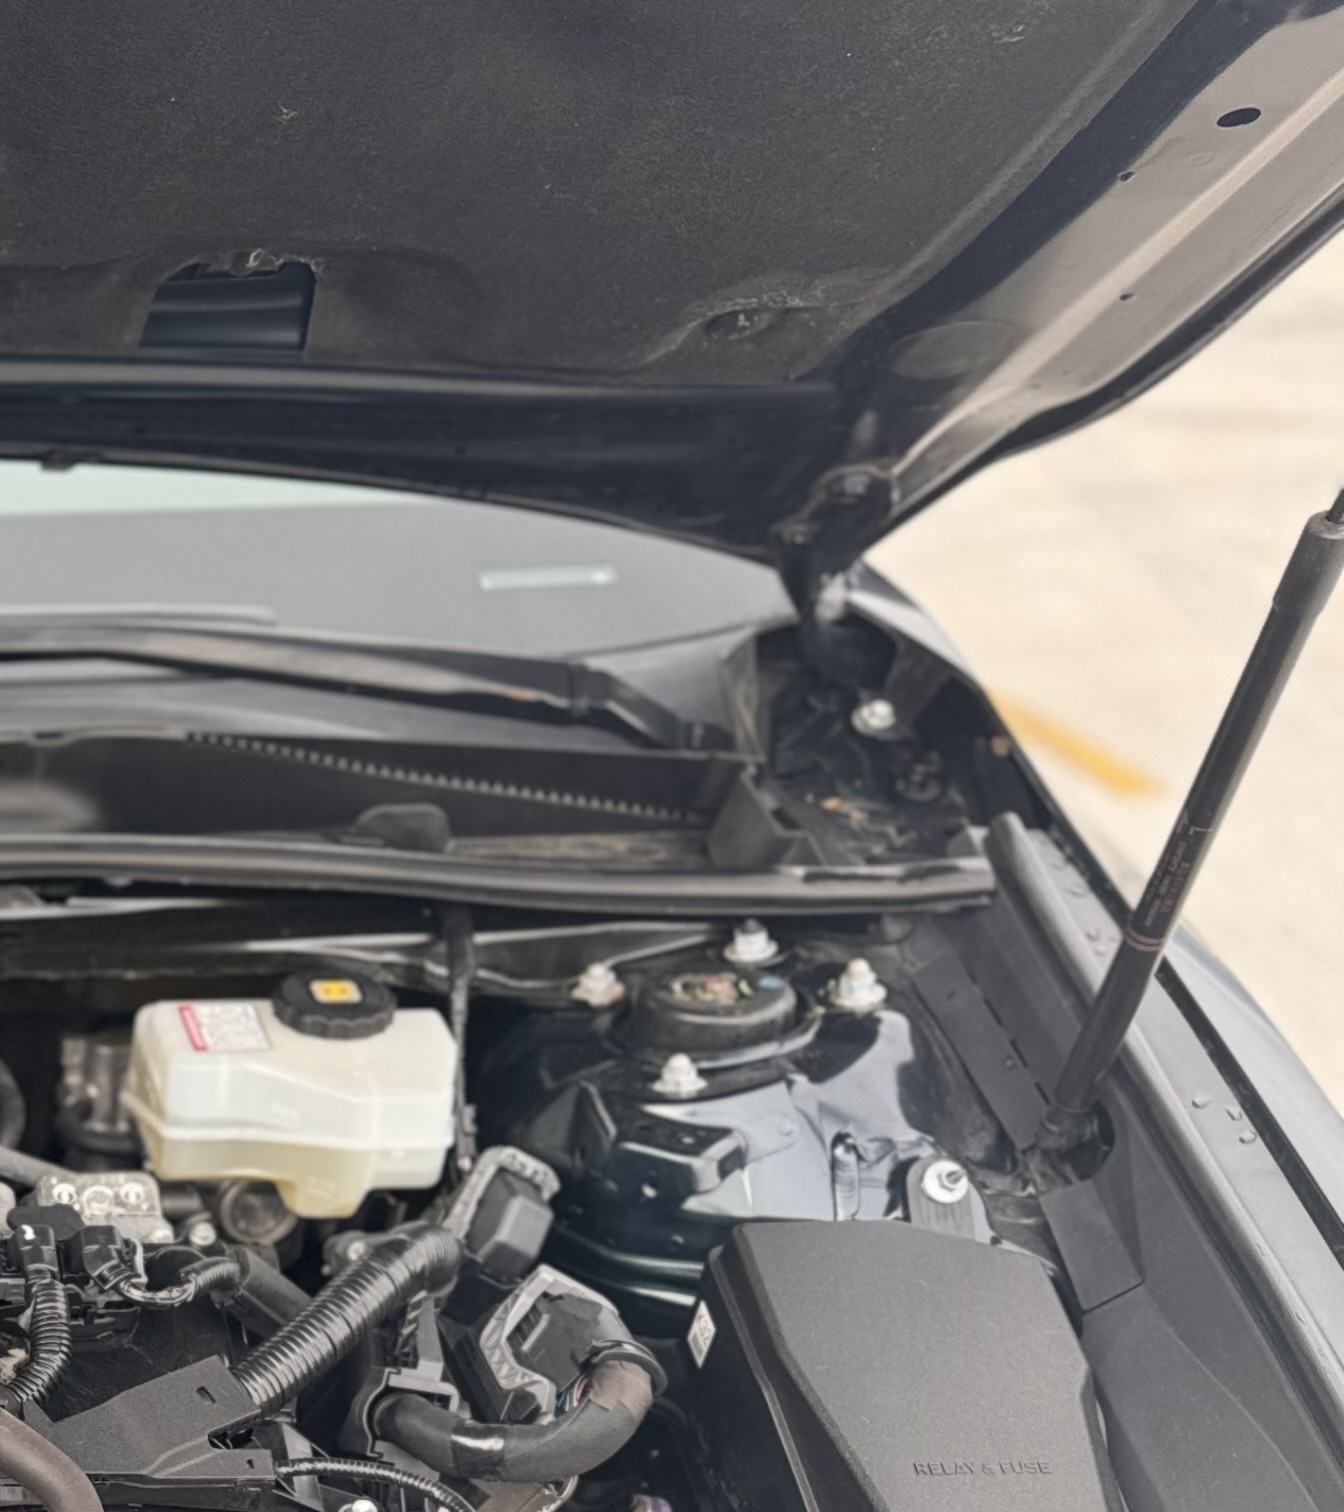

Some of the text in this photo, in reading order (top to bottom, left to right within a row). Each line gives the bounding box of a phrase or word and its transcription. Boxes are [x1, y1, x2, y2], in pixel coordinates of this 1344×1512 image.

[912, 1461, 1053, 1476] RELAY & FUSE
